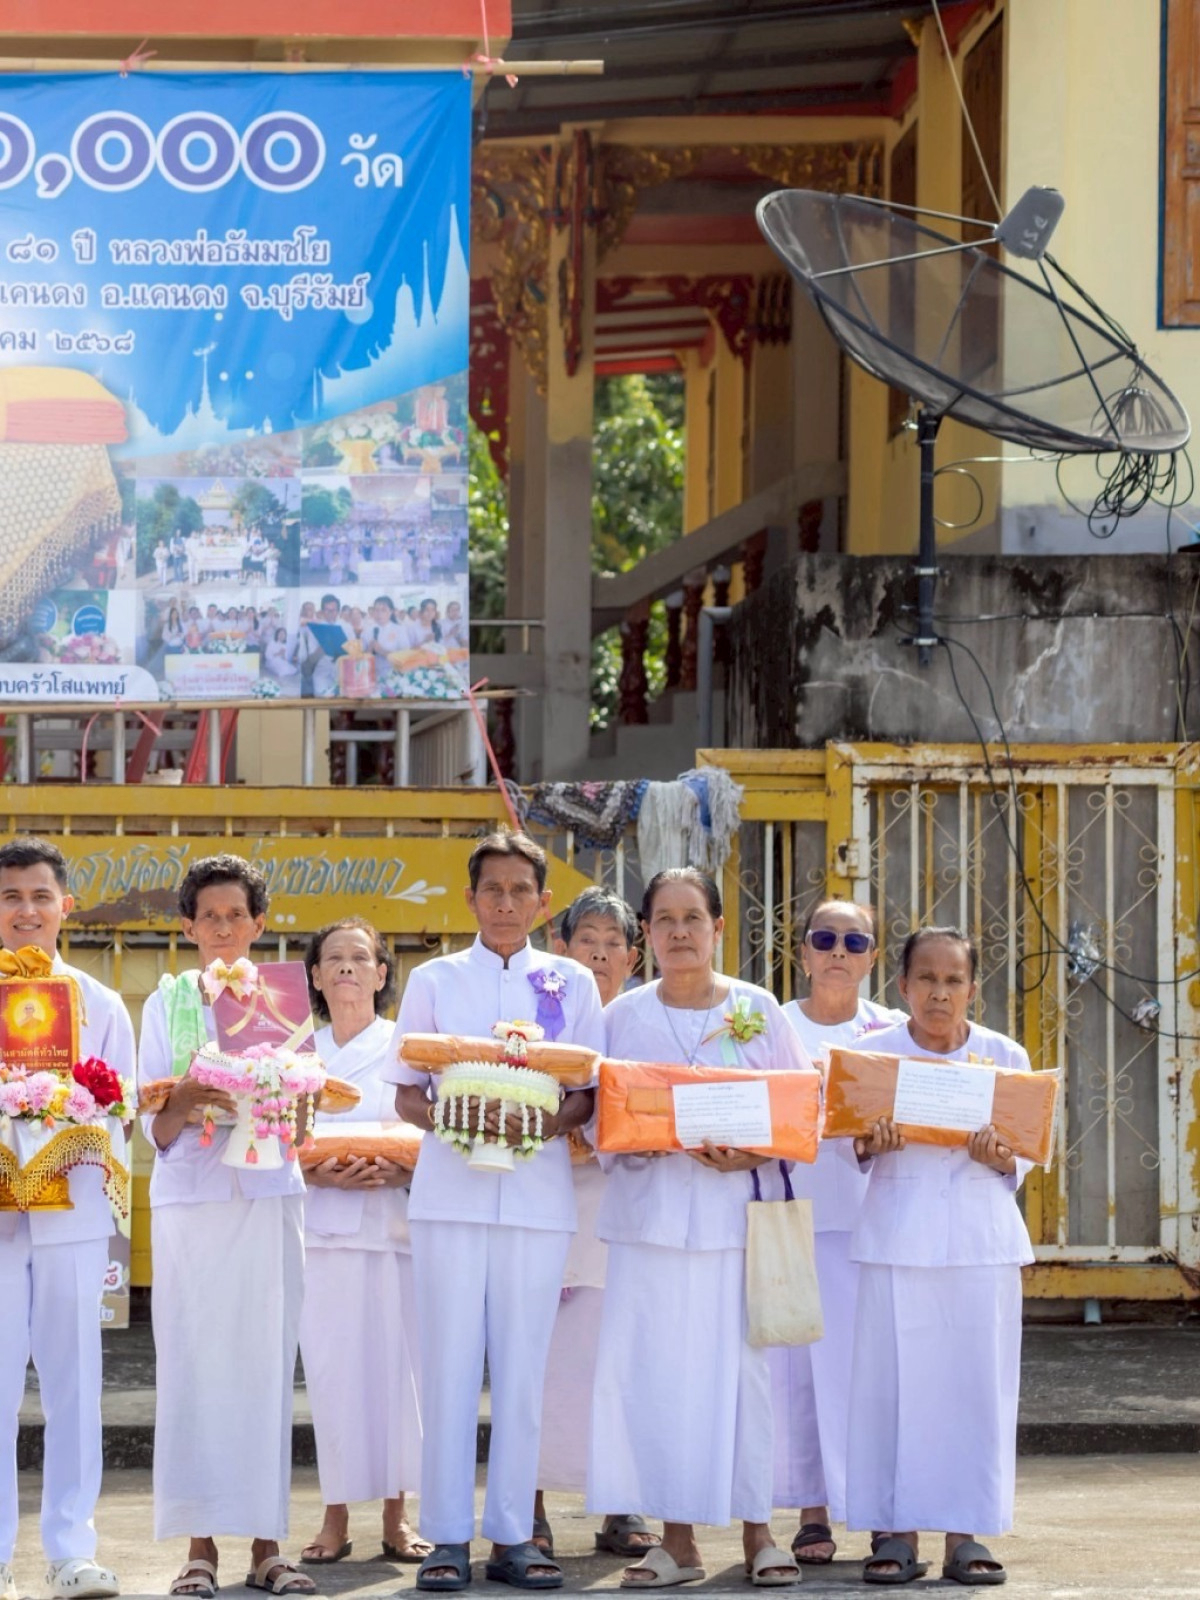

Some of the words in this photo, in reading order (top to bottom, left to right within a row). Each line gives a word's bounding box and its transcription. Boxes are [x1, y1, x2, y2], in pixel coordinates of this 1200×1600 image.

[340, 132, 404, 189] วัด
[7, 233, 58, 262] ๘๑
[73, 228, 97, 263] ปี
[110, 227, 329, 265] หลวงพ่อธัมมชโย
[101, 283, 226, 308] อ.แคนดง
[241, 273, 369, 320] จ.บุรีรัมย์
[54, 329, 134, 353] ๒๕๖๘
[66, 843, 191, 899] สามัคคี
